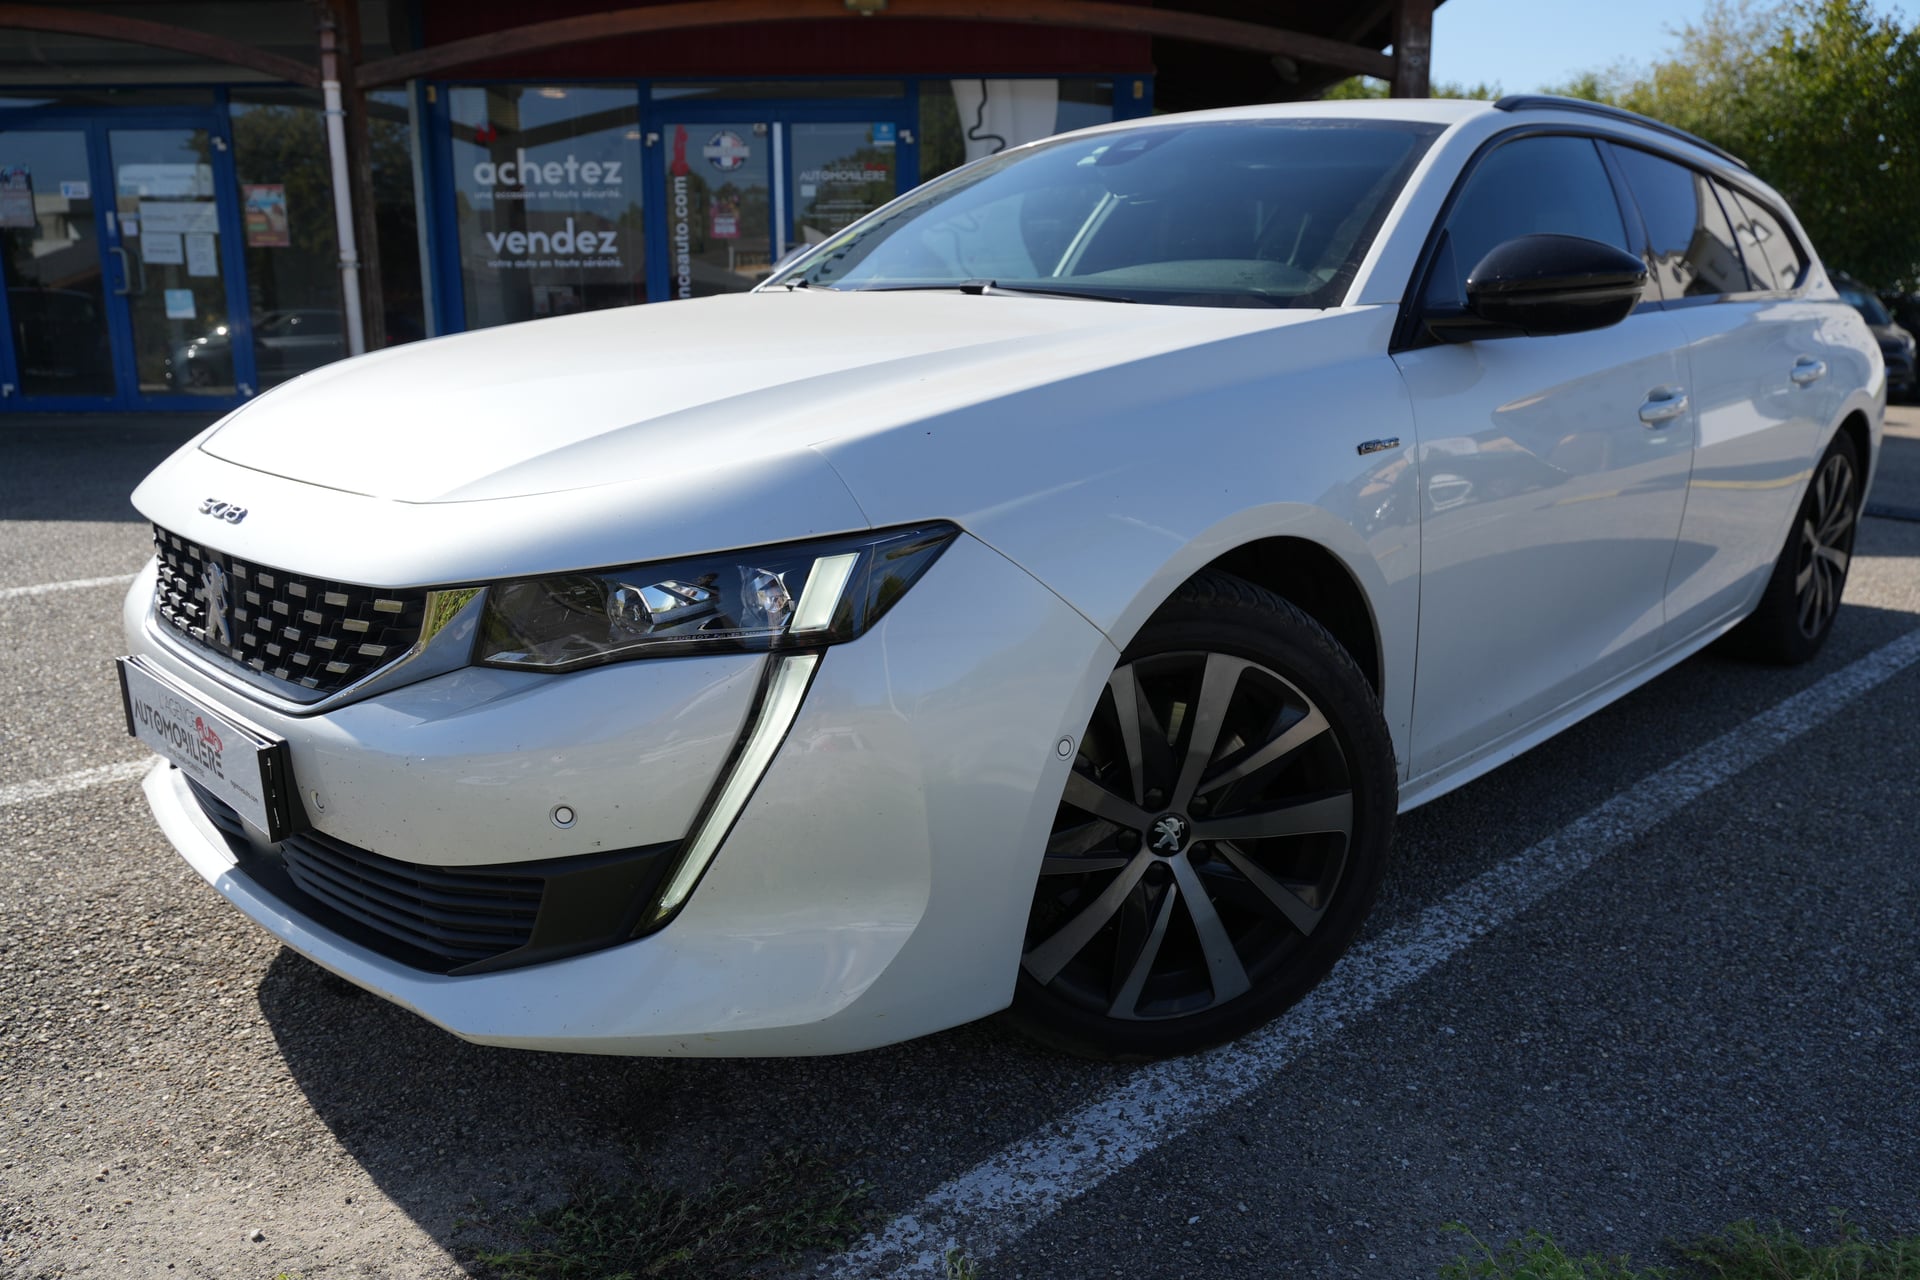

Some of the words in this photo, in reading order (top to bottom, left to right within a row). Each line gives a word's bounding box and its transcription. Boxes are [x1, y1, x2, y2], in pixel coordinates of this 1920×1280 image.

[473, 148, 623, 185] achetez
[495, 190, 535, 199] occasion
[538, 191, 549, 199] en
[553, 189, 579, 199] toute
[486, 217, 618, 254] vendez
[487, 259, 512, 268] votre
[514, 259, 537, 268] auto
[540, 260, 552, 268] en
[554, 258, 580, 268] toute
[198, 498, 248, 525] 508
